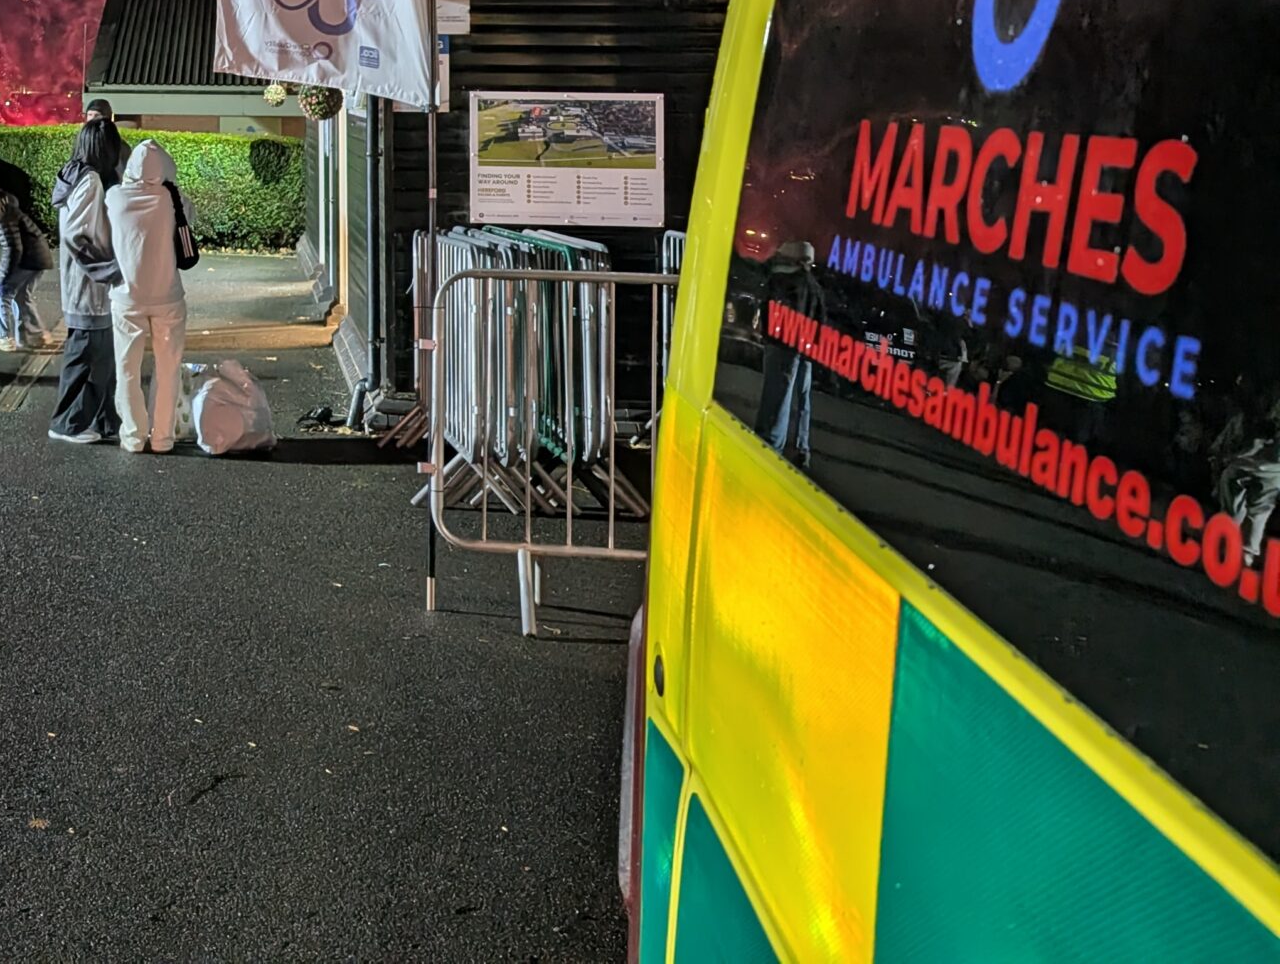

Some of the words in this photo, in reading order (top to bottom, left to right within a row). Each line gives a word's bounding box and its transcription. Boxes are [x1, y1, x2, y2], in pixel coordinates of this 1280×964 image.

[846, 119, 1198, 296] MARCHES
[827, 234, 992, 325] AMBULANCE
[1005, 288, 1202, 401] SERVICE
